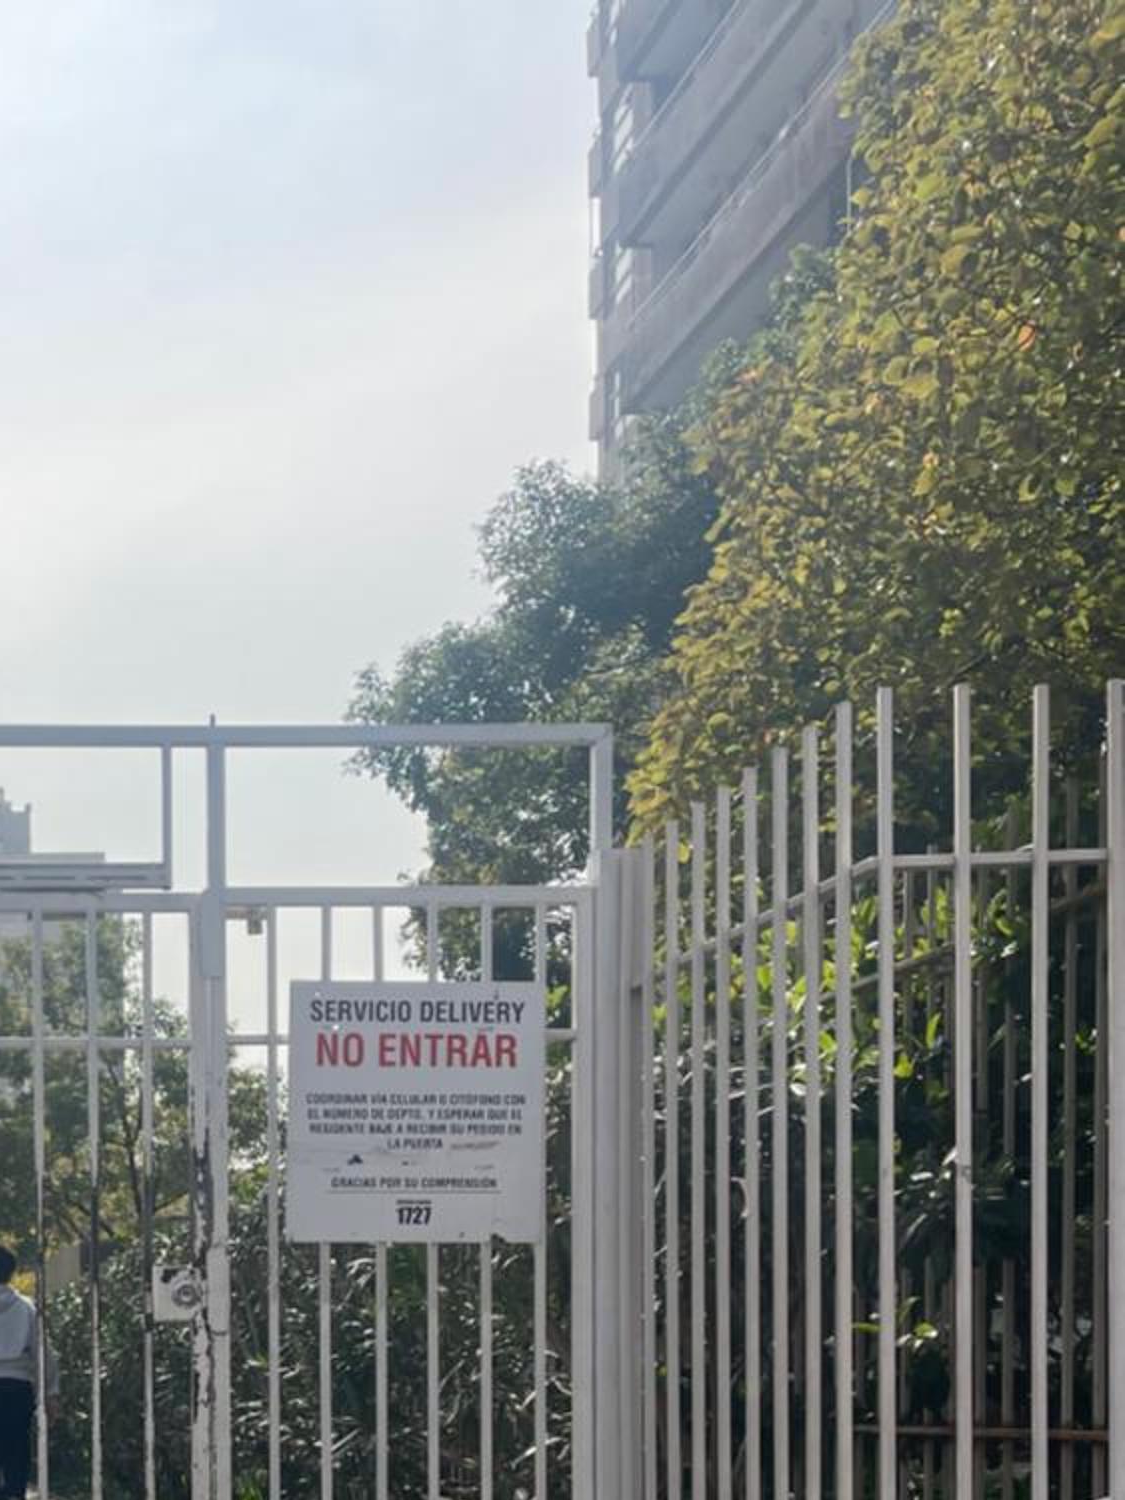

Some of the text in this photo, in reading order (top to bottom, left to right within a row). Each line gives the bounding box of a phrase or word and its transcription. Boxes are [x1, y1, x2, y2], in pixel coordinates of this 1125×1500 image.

[310, 1000, 525, 1024] SERVICIO DELIVERY
[316, 1033, 517, 1068] NO ENTRAR
[307, 1108, 320, 1120] EL
[371, 1108, 384, 1120] DE
[428, 1109, 435, 1120] Y
[437, 1108, 484, 1120] ESPERAR
[487, 1108, 508, 1120] QUE
[511, 1109, 523, 1120] EL
[309, 1123, 522, 1135] RESIDENTE BAJE A RECIBIR SU PEDIDO EN
[387, 1138, 443, 1149] LA PUERTA
[331, 1177, 376, 1188] GRACIAS
[380, 1177, 401, 1188] POR
[405, 1177, 418, 1188] SU
[395, 1207, 432, 1225] 1727
